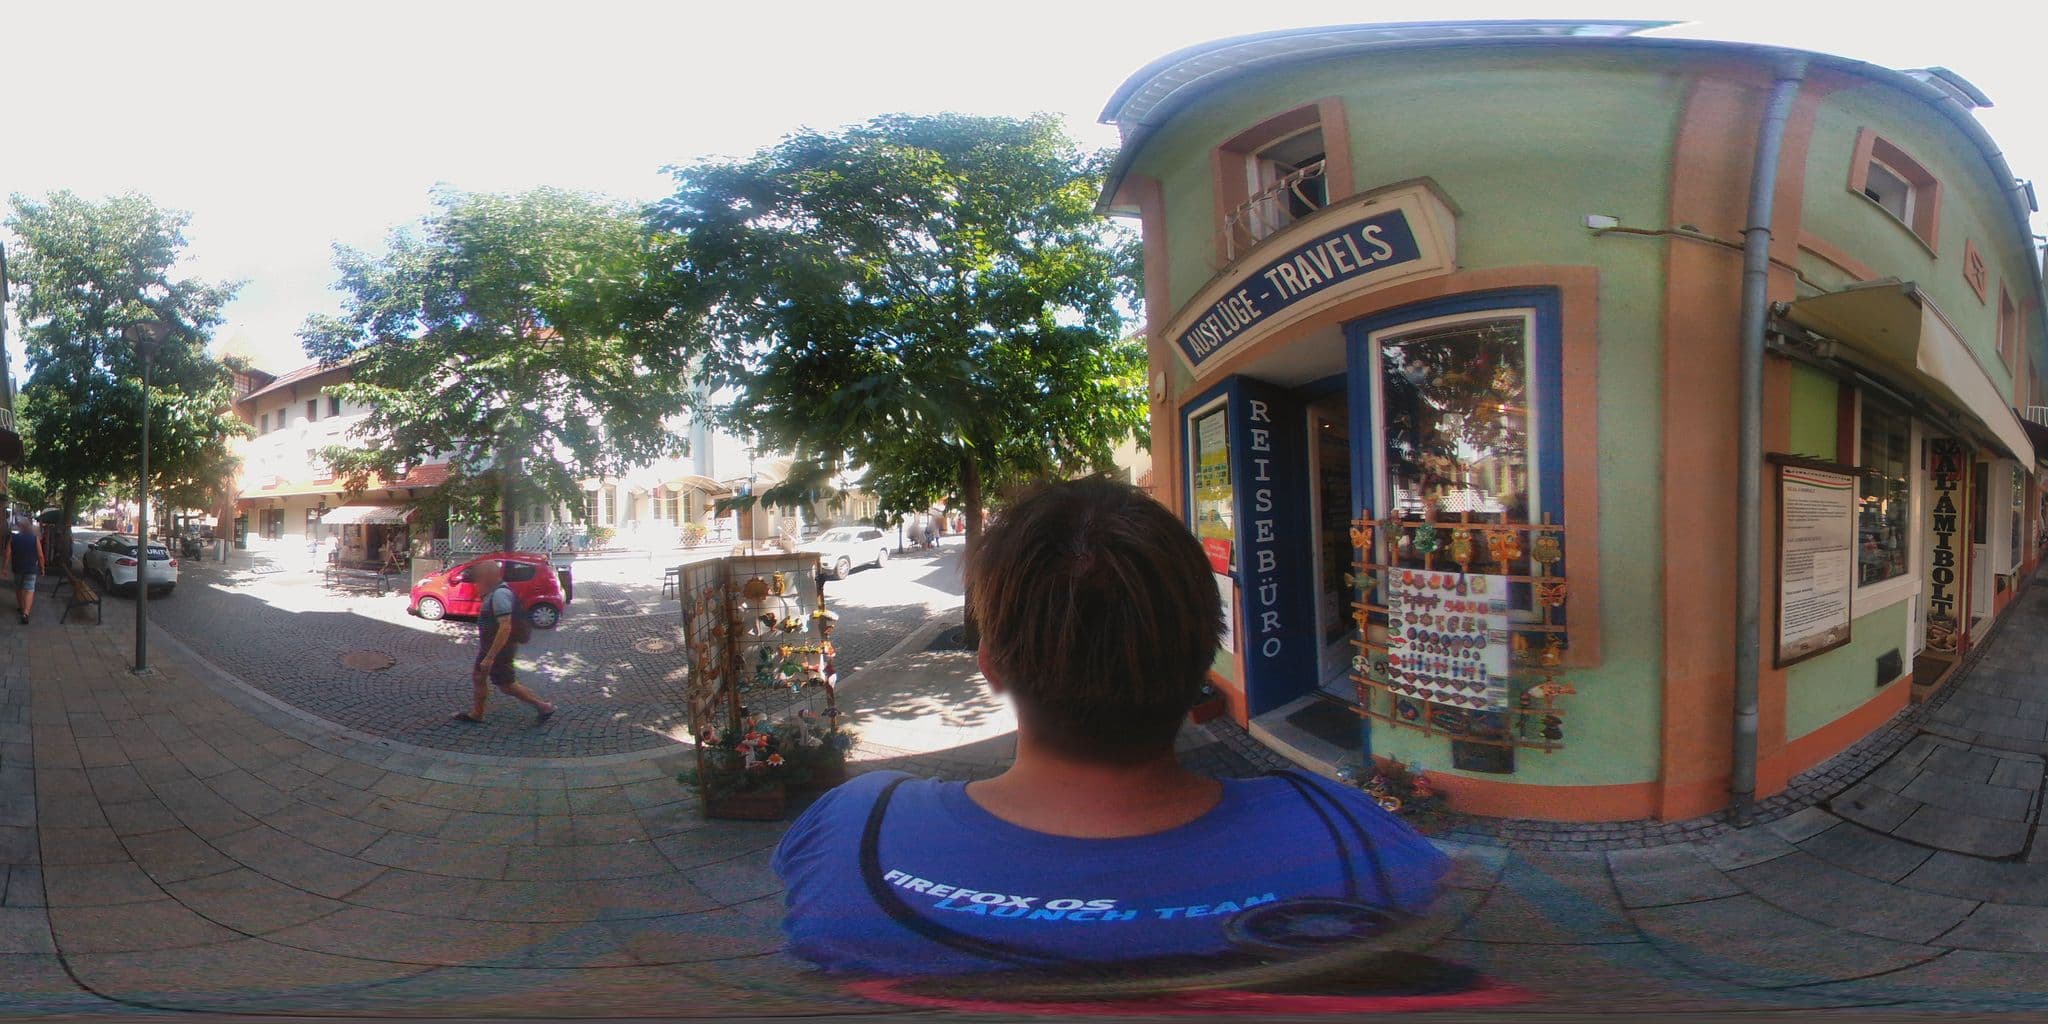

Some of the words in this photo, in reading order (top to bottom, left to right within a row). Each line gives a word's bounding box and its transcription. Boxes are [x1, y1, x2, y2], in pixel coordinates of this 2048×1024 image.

[1186, 288, 1262, 358] AUSFLÜGE
[1264, 224, 1393, 300] TRAVELS
[1250, 400, 1281, 658] REISEBÜRO
[131, 548, 168, 556] SURITY
[884, 869, 1039, 910] FIREFOX
[1045, 899, 1118, 911] OS
[933, 897, 1139, 922] LAUNCH
[1154, 892, 1277, 920] TEAM
